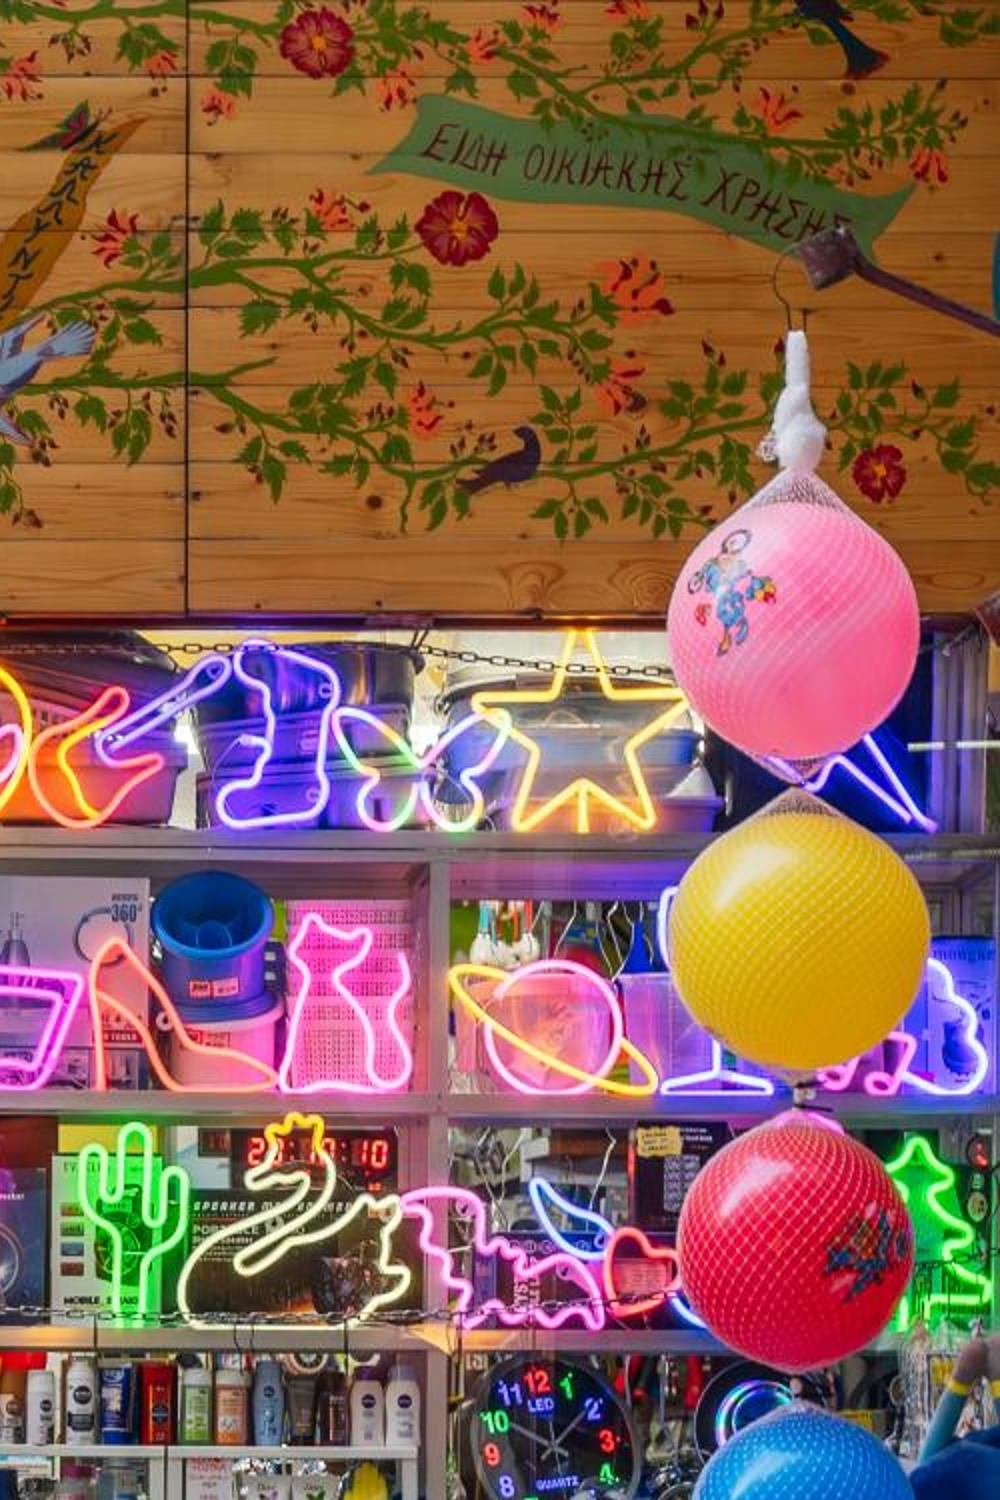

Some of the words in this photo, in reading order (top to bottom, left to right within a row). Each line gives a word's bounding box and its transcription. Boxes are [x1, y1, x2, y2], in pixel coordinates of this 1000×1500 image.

[419, 123, 509, 167] ΕΙΔΗ
[523, 143, 693, 202] ΟΙΚΙΑΚΗΣ
[523, 1369, 552, 1394] 12
[498, 1382, 524, 1407] 11
[527, 1398, 555, 1413] LED
[481, 1410, 510, 1435] 10
[599, 1429, 616, 1453] 3
[484, 1443, 501, 1467] 9
[501, 1475, 516, 1498] 8
